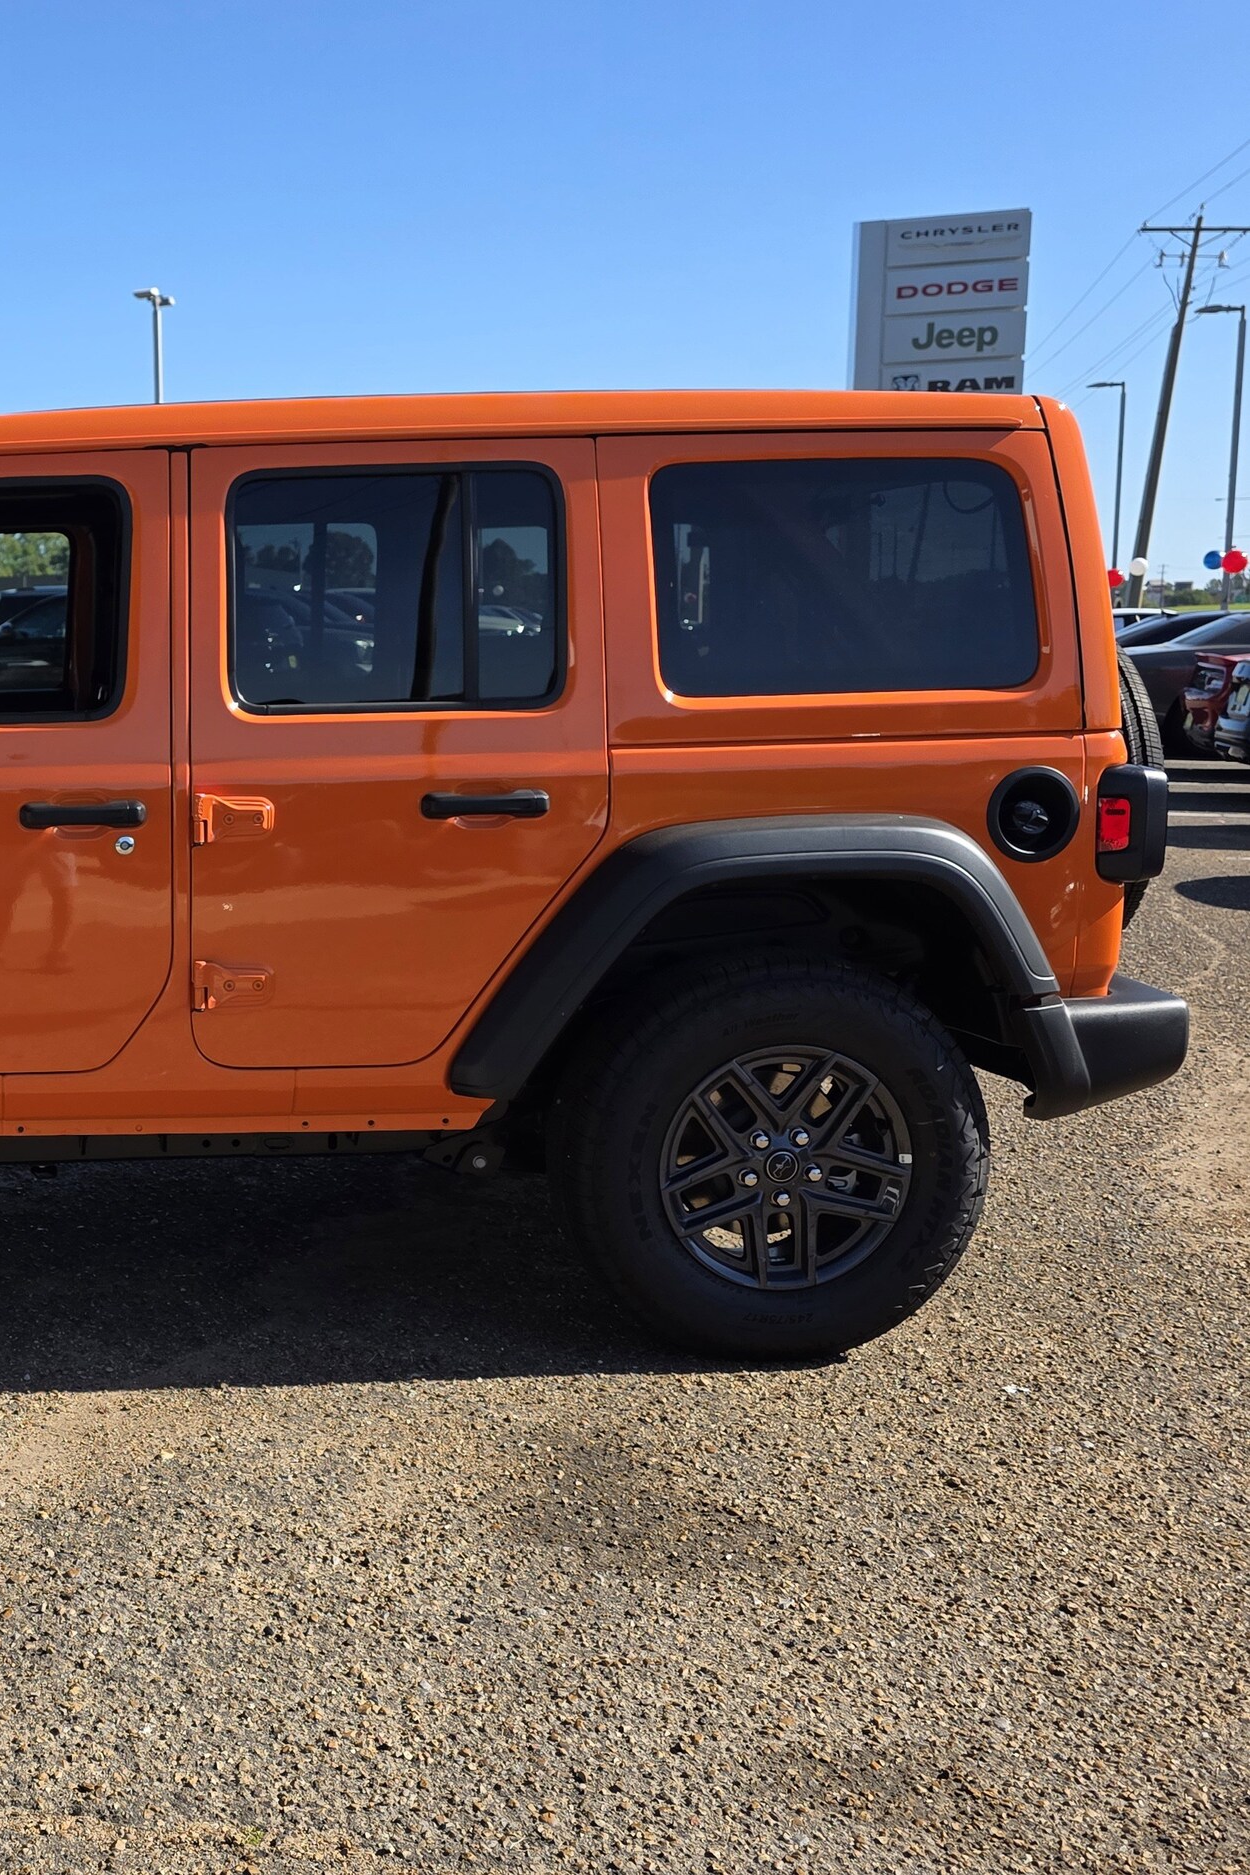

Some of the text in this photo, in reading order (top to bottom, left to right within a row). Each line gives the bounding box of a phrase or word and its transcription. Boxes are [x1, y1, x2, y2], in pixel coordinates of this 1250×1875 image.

[900, 223, 1019, 240] CHRYSLER
[896, 278, 1019, 299] DODGE
[911, 322, 999, 352] Jeep
[928, 376, 1015, 392] RAM
